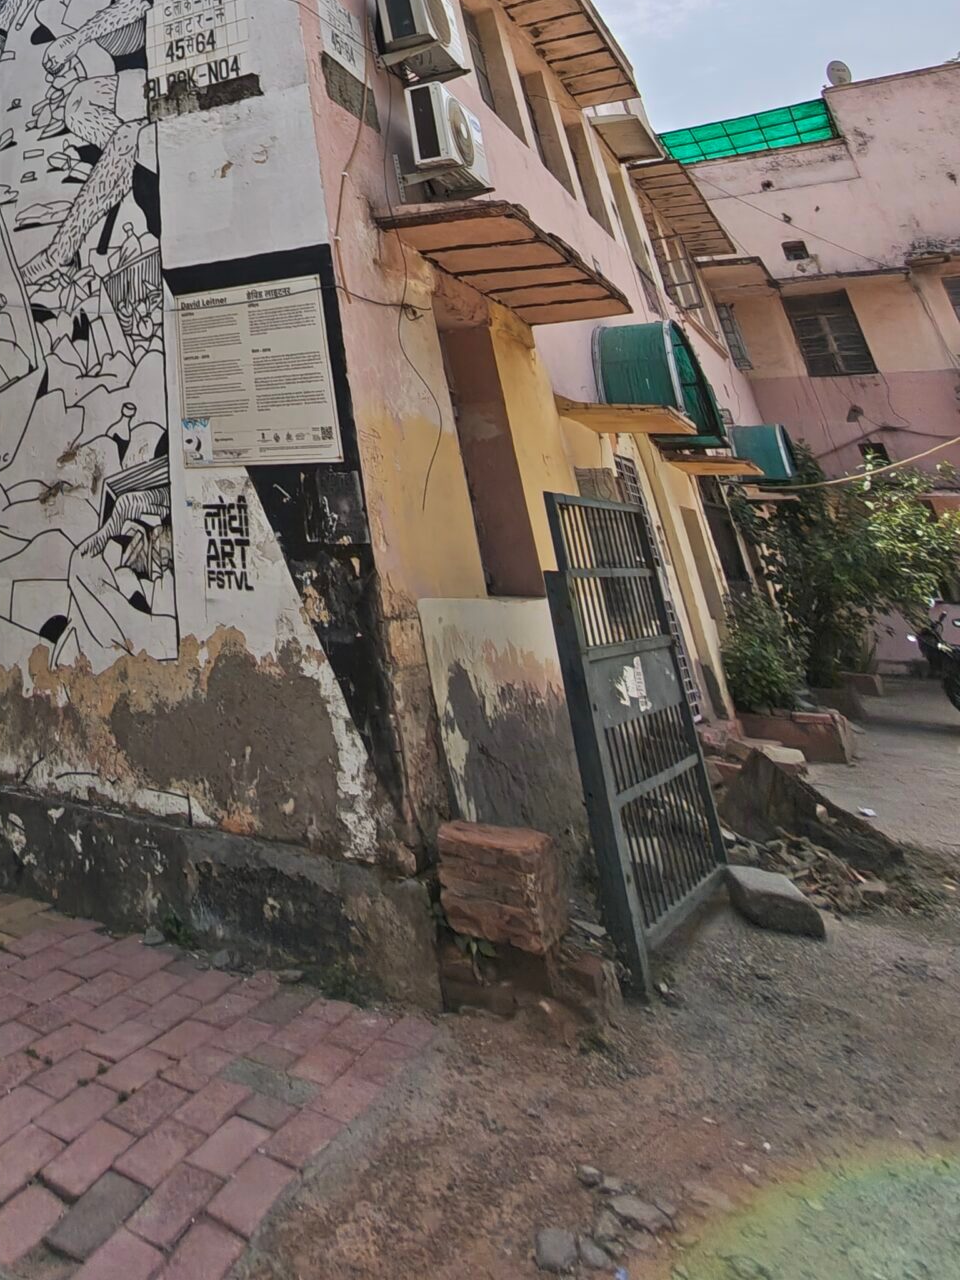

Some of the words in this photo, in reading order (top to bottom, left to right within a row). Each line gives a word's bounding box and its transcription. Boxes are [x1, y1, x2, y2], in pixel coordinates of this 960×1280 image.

[180, 299, 200, 310] David
[201, 297, 227, 307] Leitner
[206, 539, 250, 569] ART
[207, 570, 254, 591] FSTVL
